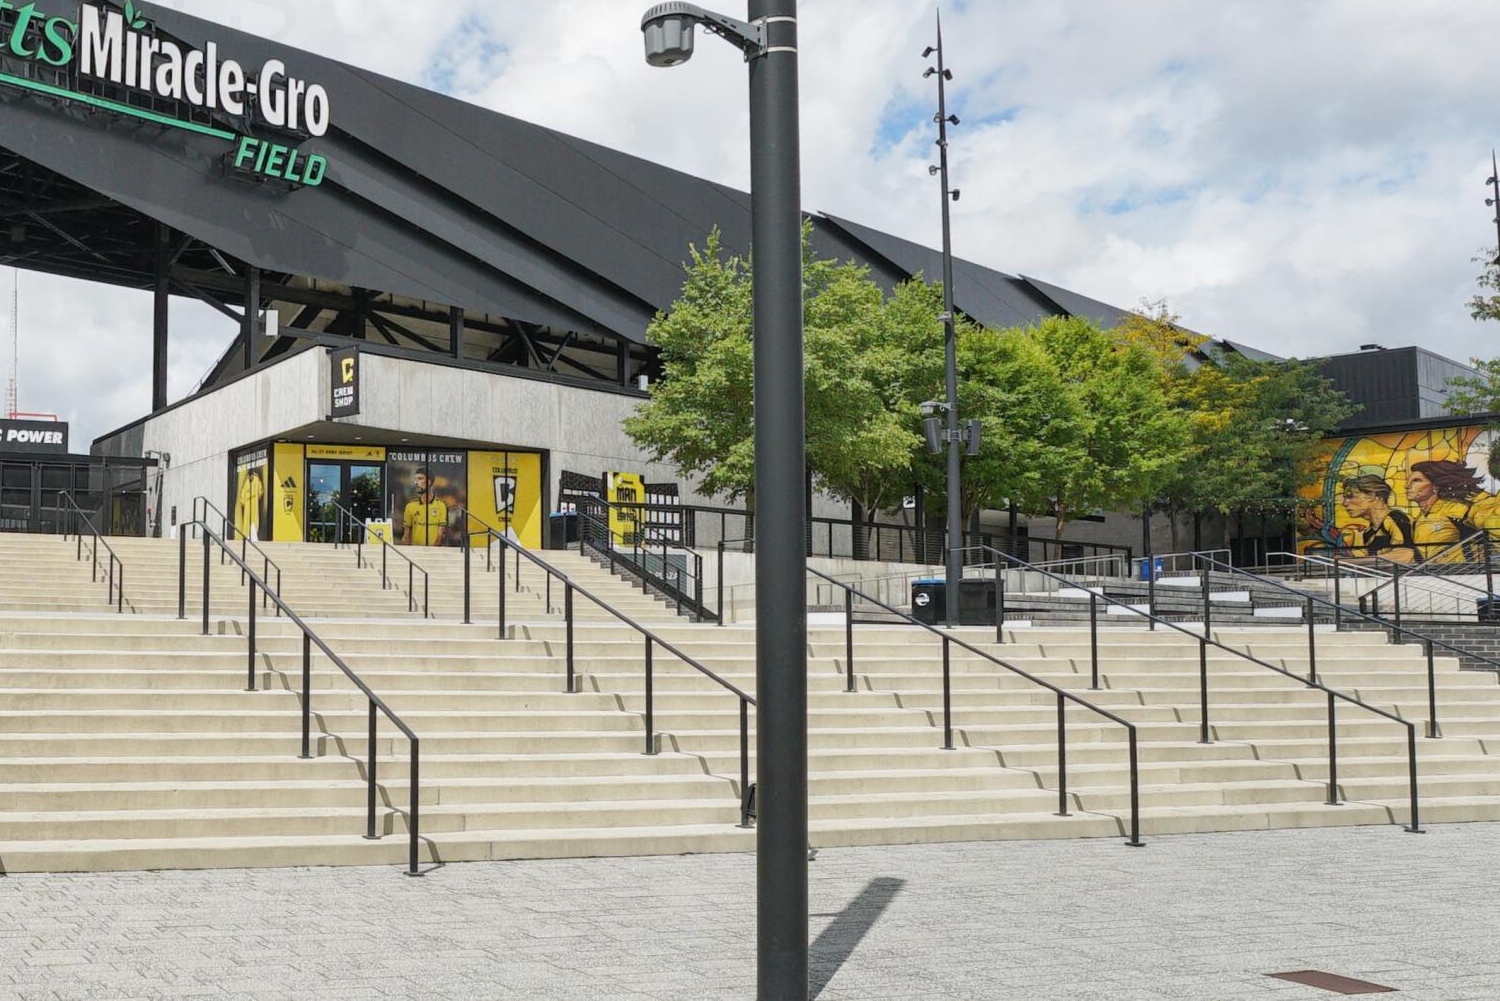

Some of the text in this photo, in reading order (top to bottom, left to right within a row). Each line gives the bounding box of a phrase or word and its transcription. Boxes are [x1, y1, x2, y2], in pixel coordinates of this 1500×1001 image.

[235, 135, 328, 188] FIELD
[333, 385, 354, 398] CREW
[334, 396, 354, 408] SHOP
[6, 429, 63, 445] POWER
[391, 452, 463, 463] COLUMBUS CREW
